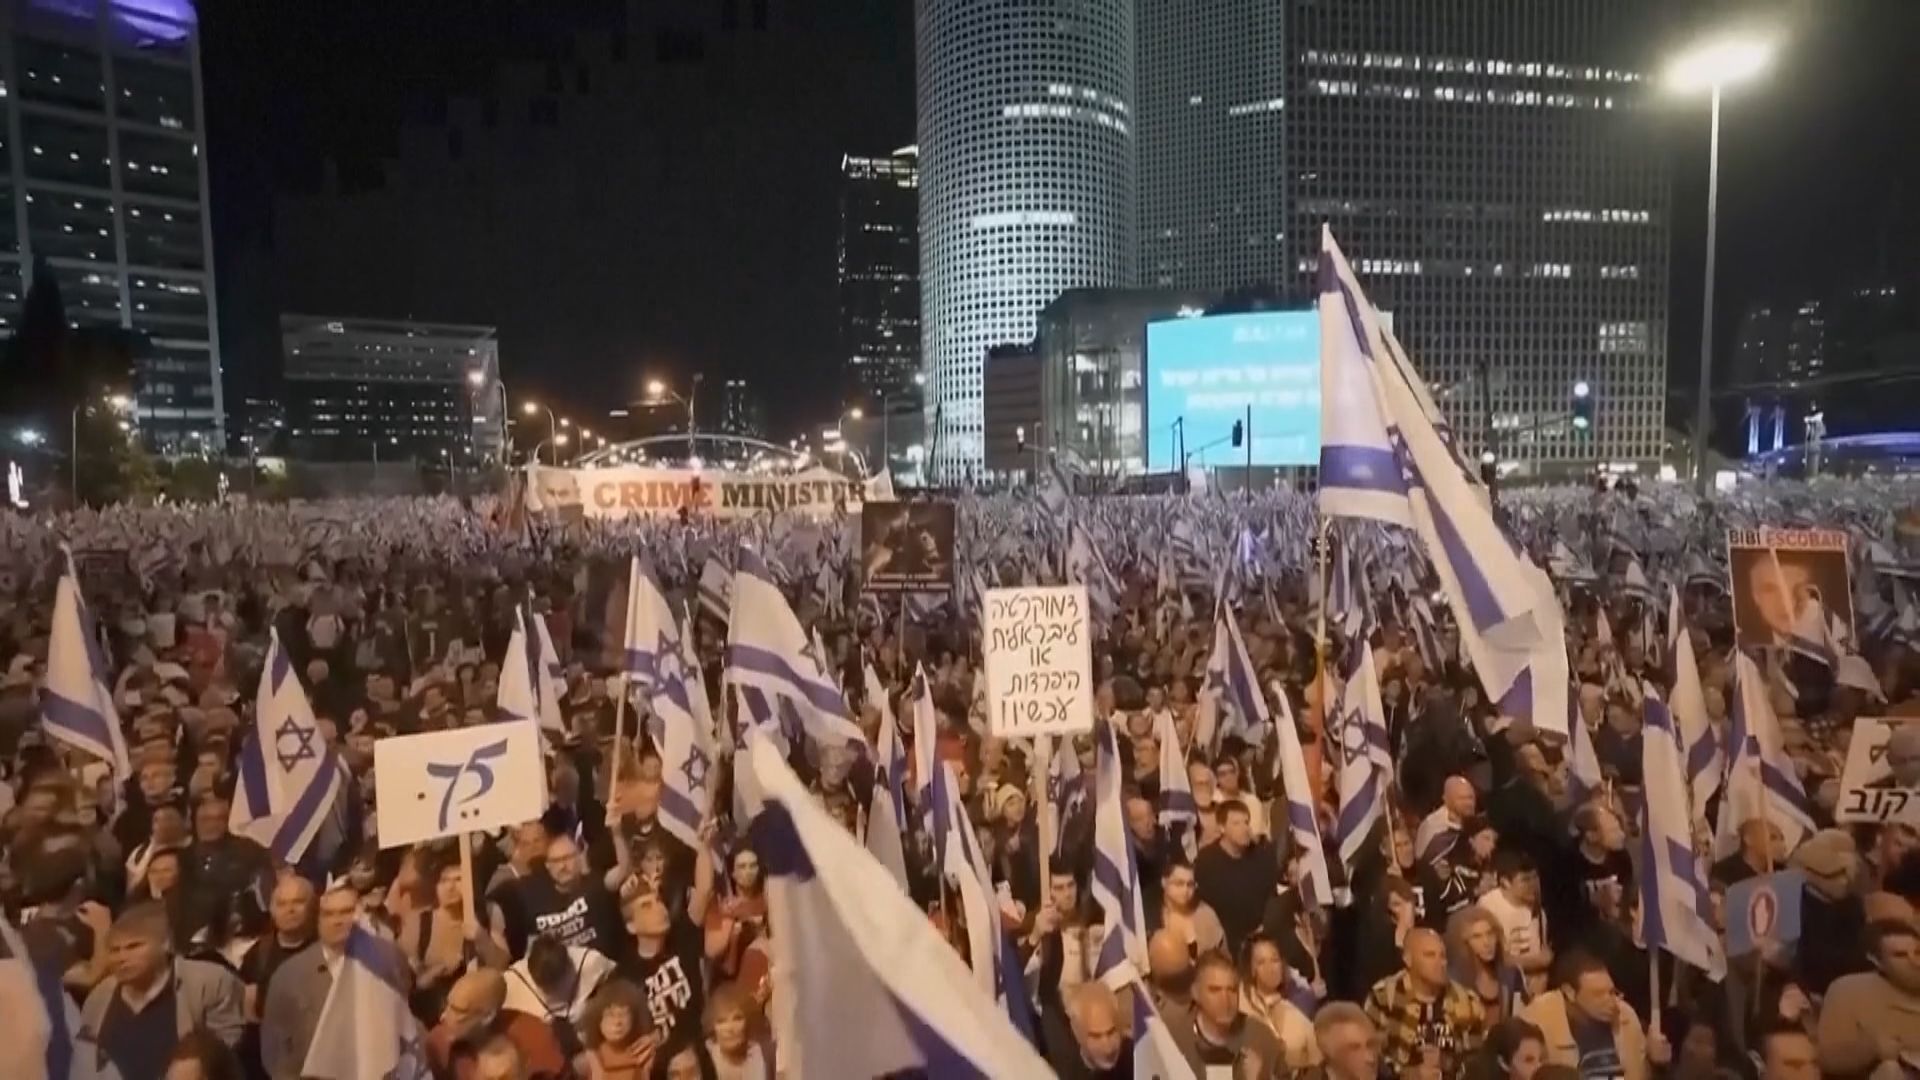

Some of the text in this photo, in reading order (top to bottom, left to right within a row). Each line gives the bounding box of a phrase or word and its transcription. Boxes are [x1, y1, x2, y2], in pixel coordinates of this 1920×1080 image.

[593, 480, 867, 508] CRIME MINISTER
[1729, 529, 1761, 545] BIBI
[991, 594, 1078, 622] דמוקרטיה
[991, 618, 1083, 652] ליבראלית
[1030, 647, 1051, 667] או
[1002, 670, 1080, 696] היפרדות
